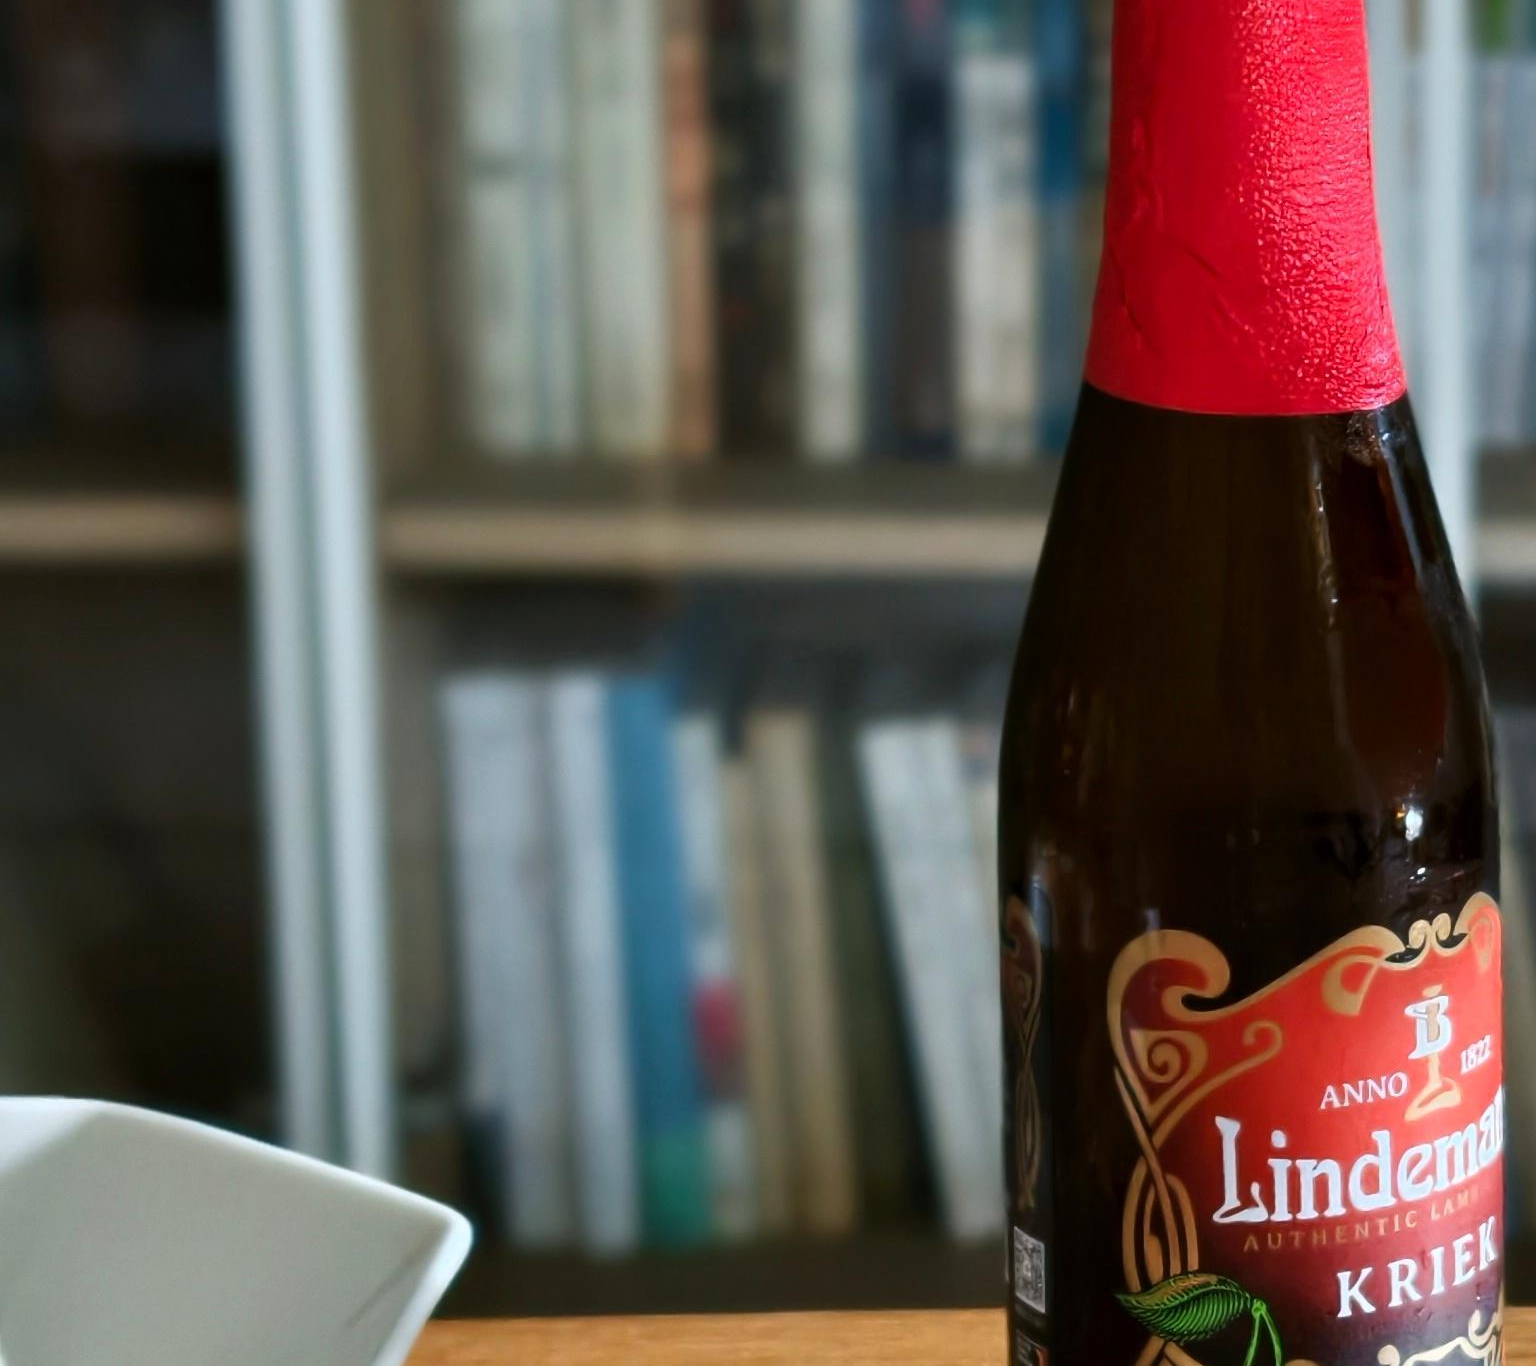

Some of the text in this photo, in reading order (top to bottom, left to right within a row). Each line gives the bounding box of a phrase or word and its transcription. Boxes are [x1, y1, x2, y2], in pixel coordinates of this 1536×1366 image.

[1319, 1071, 1409, 1111] ANNO
[1243, 1210, 1418, 1253] AUTHENTIC
[1336, 1215, 1499, 1318] KRIEK
